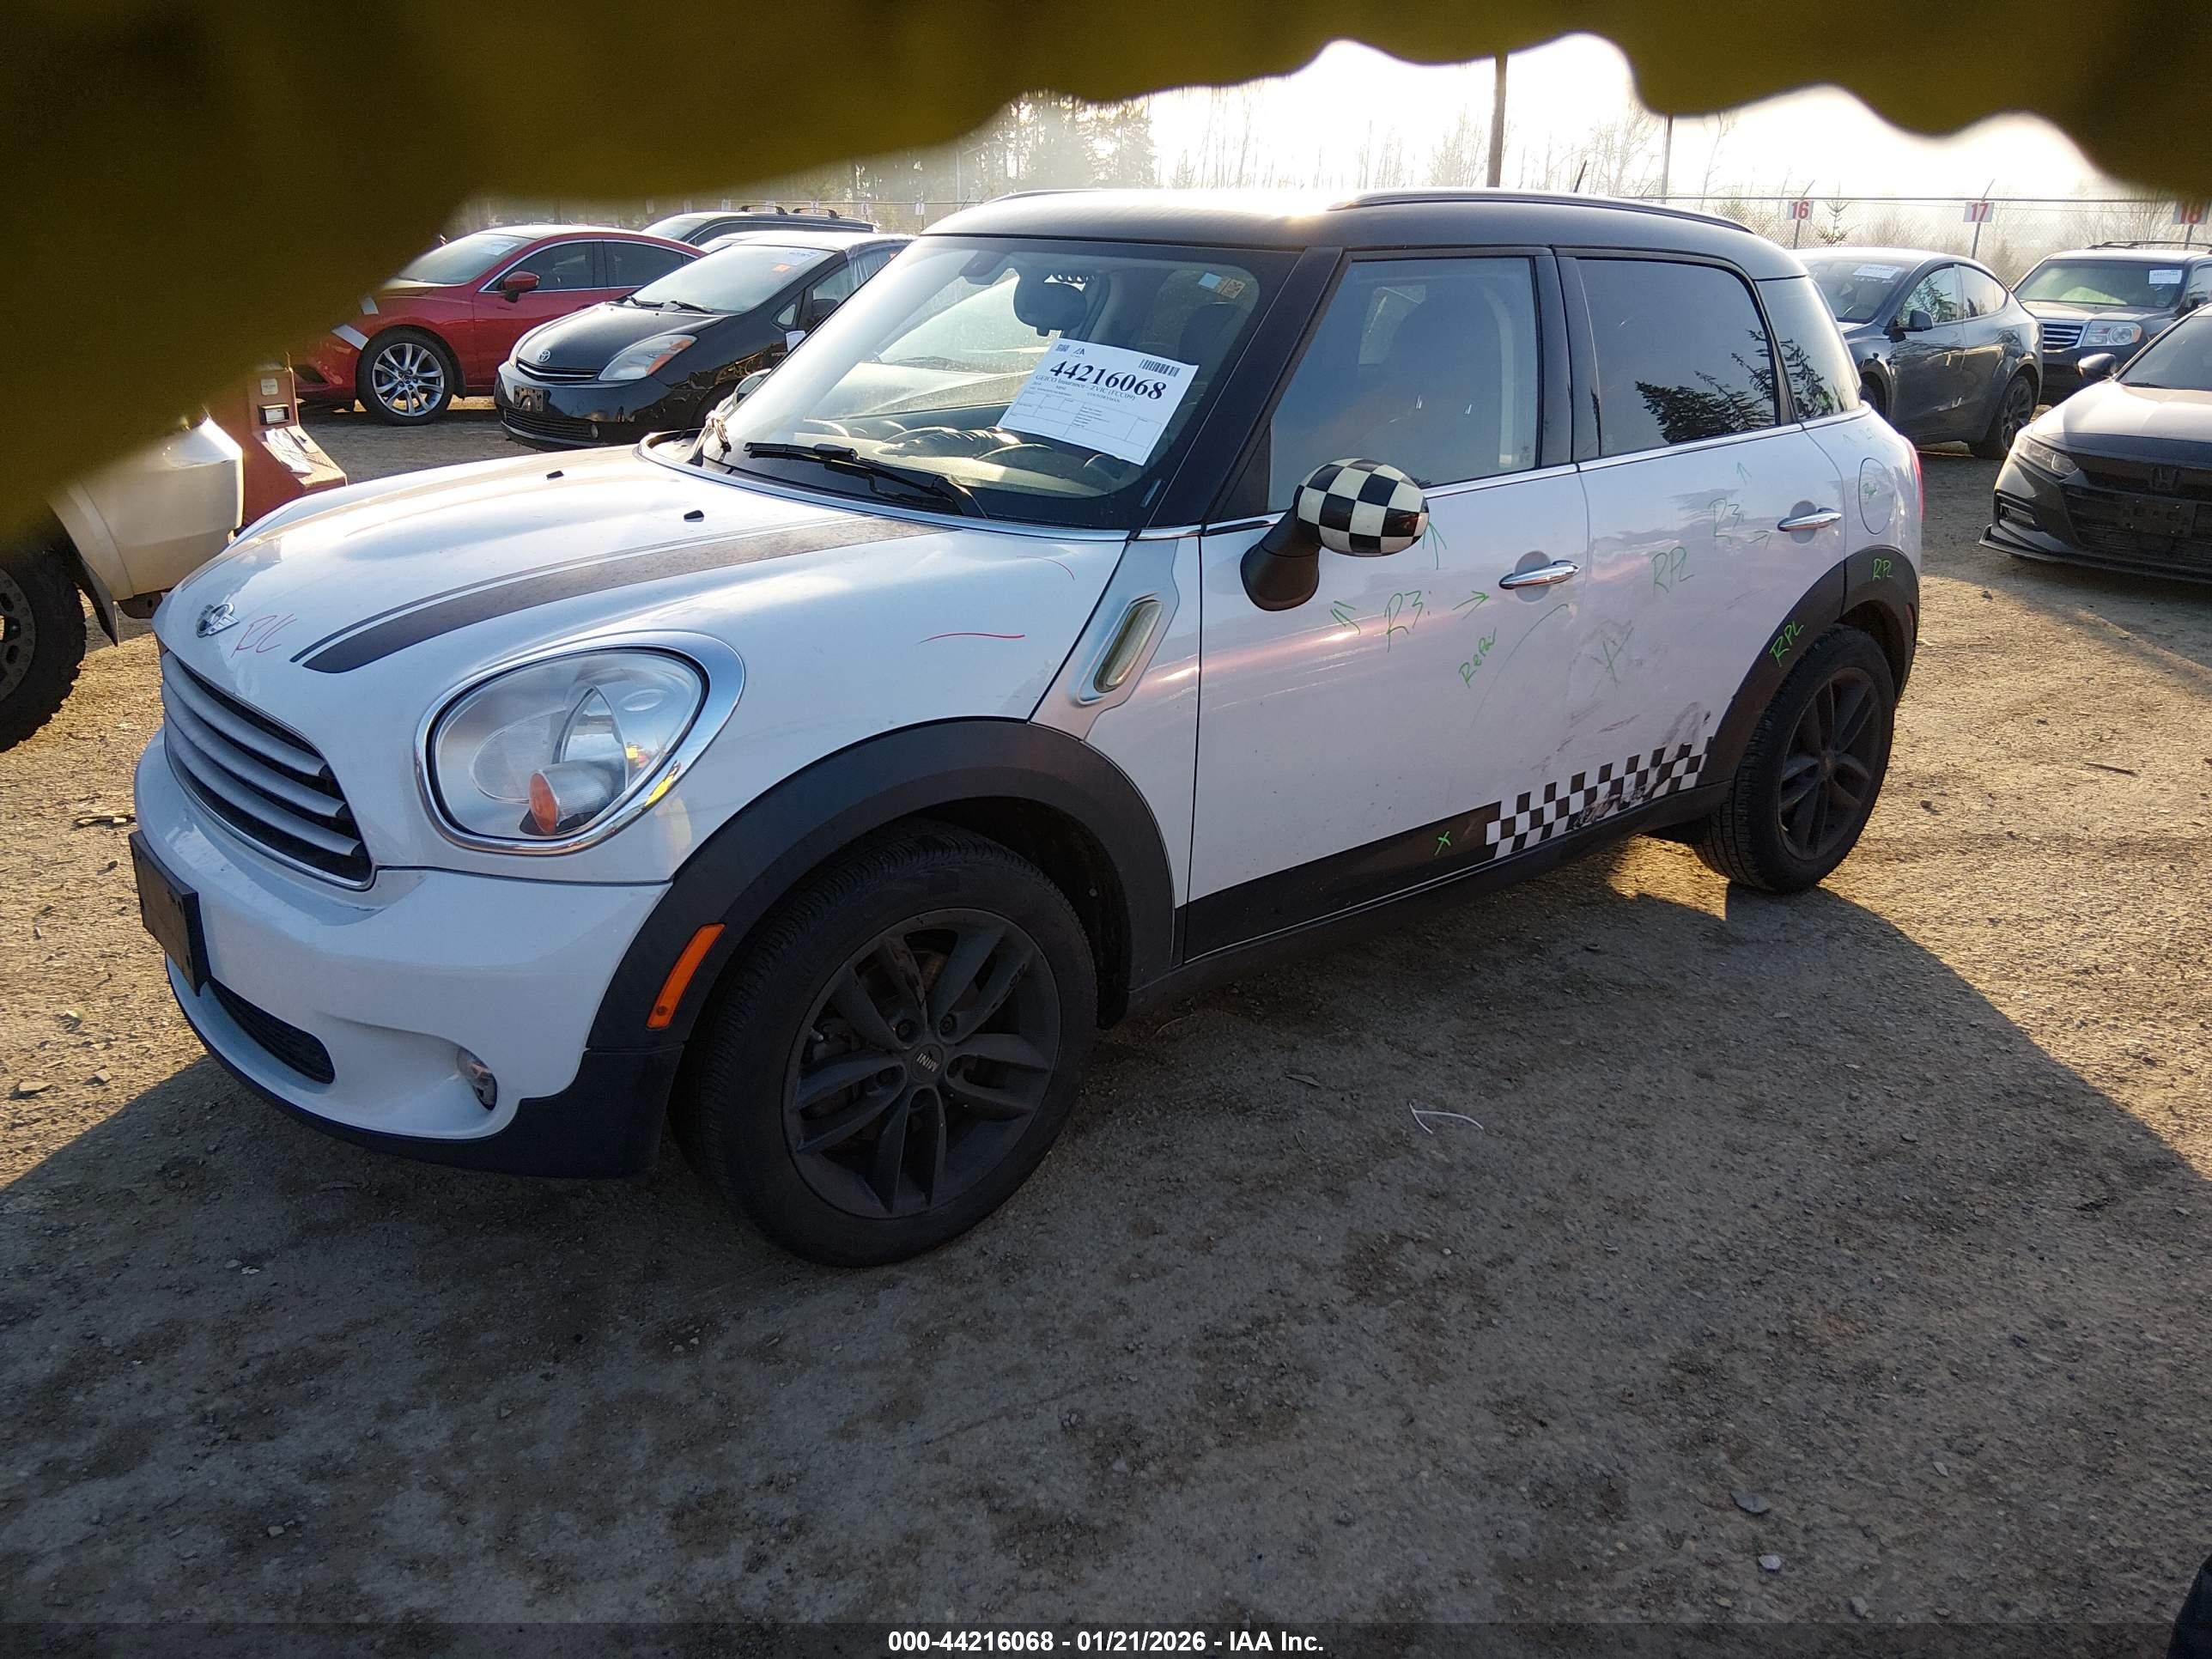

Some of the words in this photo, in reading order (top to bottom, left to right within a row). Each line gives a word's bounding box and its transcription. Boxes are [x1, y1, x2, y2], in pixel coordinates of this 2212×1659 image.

[1791, 201, 1809, 220] 16
[1971, 203, 1990, 222] 17
[1036, 374, 1057, 383] GEICO
[1058, 378, 1086, 389] Insurance
[1050, 361, 1167, 400] 44216068
[1769, 620, 1804, 667] RPL
[916, 1052, 939, 1073] MINI
